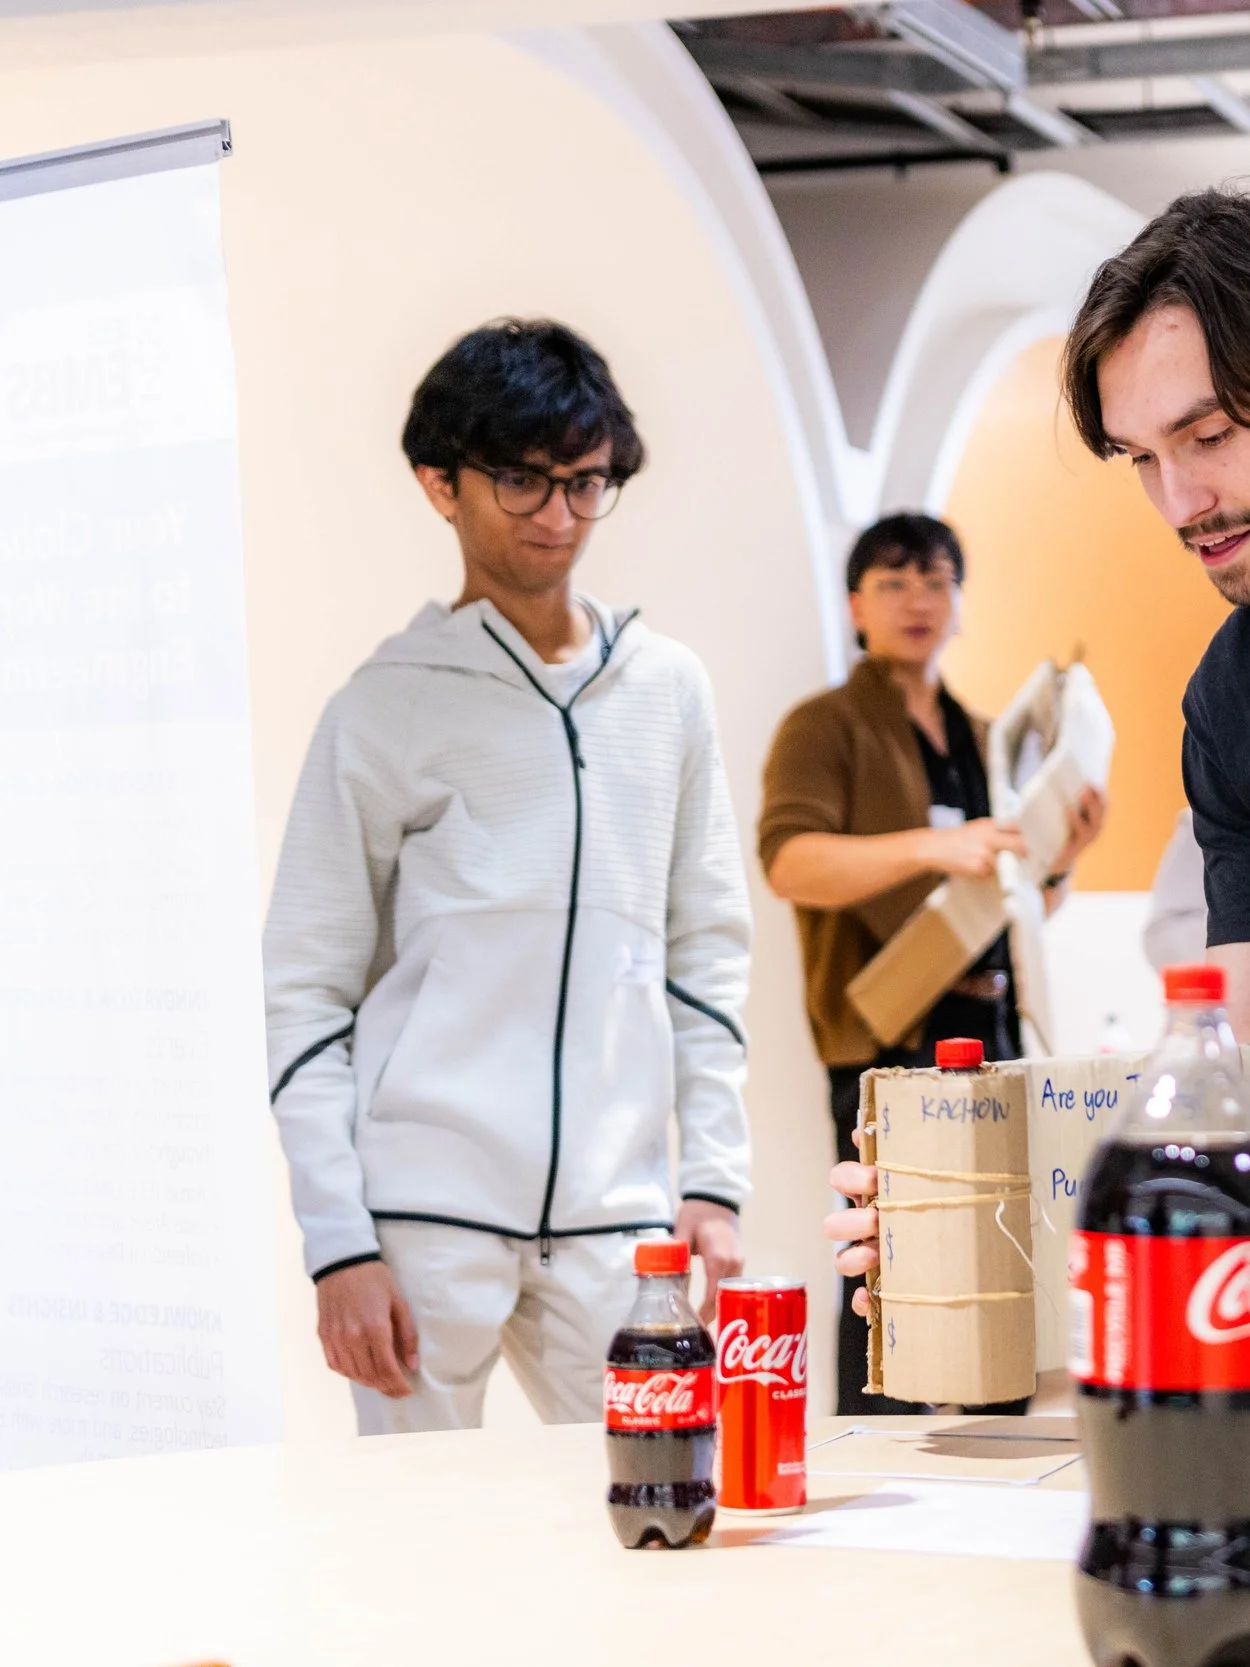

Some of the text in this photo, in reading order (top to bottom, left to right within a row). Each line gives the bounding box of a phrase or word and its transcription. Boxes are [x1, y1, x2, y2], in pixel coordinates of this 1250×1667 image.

[921, 1095, 1010, 1122] KACHOW
[1041, 1077, 1075, 1112] Are
[1084, 1089, 1119, 1121] you
[605, 1370, 698, 1415] Coca-Cola
